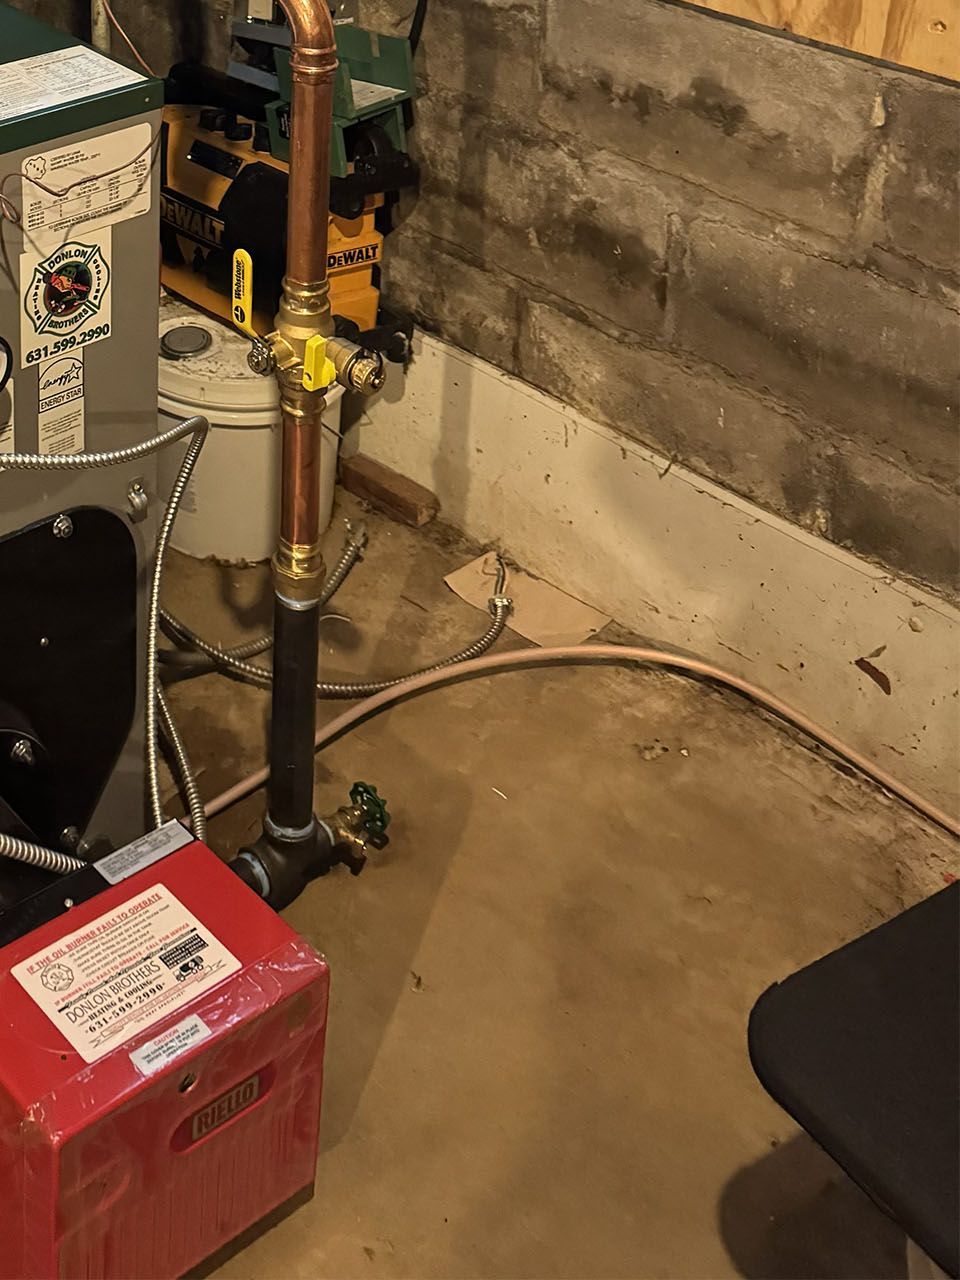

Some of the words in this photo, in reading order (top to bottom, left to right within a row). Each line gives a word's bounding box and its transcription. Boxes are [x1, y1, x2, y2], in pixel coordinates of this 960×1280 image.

[47, 249, 89, 270] DONLON
[92, 259, 102, 301] COOLING
[32, 278, 42, 321] HEATING
[47, 308, 89, 329] BROTHERS
[25, 323, 110, 364] 631.599.2990
[40, 394, 66, 410] ENERGY
[66, 388, 82, 401] STAR
[41, 370, 74, 390] energy
[25, 964, 37, 975] IF
[34, 954, 54, 969] THE
[50, 946, 68, 960] OIL
[64, 928, 98, 951] BURNER
[94, 916, 120, 934] FAILS
[115, 910, 130, 921] TO
[126, 891, 163, 915] OPERATE
[63, 988, 114, 1024] DONLON
[107, 959, 162, 996] BROTHERS
[85, 981, 165, 1034] 631-599-2990
[86, 999, 118, 1021] HEATING
[122, 978, 153, 999] COOLING
[152, 1027, 180, 1047] CAUTION
[184, 1023, 198, 1033] PLACE
[197, 1082, 254, 1134] RIELLO
